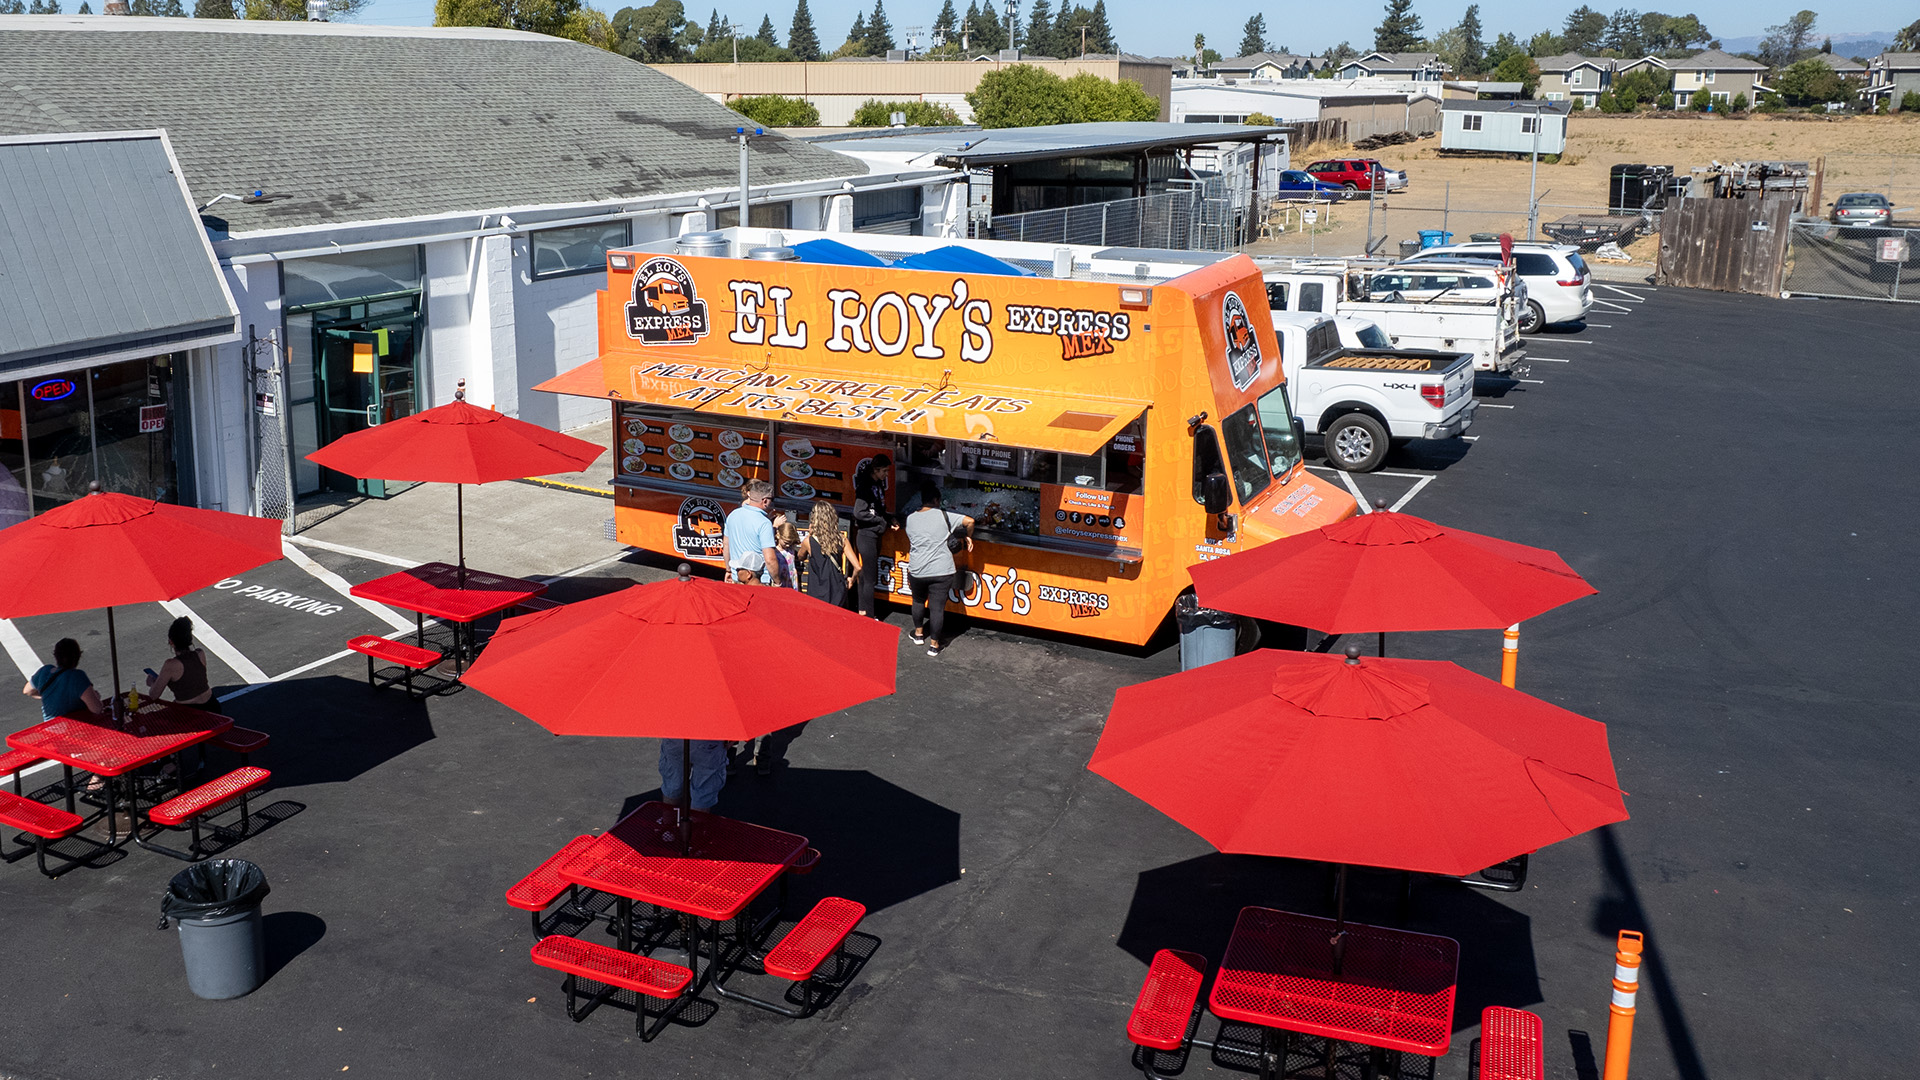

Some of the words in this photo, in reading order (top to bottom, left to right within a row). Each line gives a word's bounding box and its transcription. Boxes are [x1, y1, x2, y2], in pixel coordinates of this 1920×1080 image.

[639, 267, 653, 283] EL
[656, 262, 687, 282] ROY'S
[633, 315, 702, 331] EXPRESS
[728, 279, 807, 350] EL
[825, 277, 993, 364] ROY'S
[1005, 304, 1131, 341] EXPRESS
[665, 322, 695, 341] MEX
[1061, 328, 1114, 361] MEX
[34, 380, 71, 400] OPEN
[638, 361, 788, 389] MEXICAN
[786, 378, 930, 403] STREET
[928, 391, 1032, 413] EATS
[669, 386, 734, 402] AT
[722, 392, 795, 411] ITS
[793, 398, 898, 422] BEST
[1113, 443, 1136, 452] ORDERS
[1115, 435, 1134, 443] PHONE
[961, 446, 981, 455] ORDER
[982, 448, 990, 456] BY
[991, 450, 1011, 459] PHONE
[1075, 491, 1097, 500] Follow
[678, 535, 724, 548] EXPRES
[1054, 526, 1128, 542] @elroysexpressmex
[1195, 545, 1214, 553] SANTA
[1215, 547, 1231, 556] ROSA
[214, 578, 243, 590] O
[233, 585, 343, 616] PARKING
[948, 567, 1031, 616] OY'S
[1038, 585, 1109, 609] EXPRESS
[1070, 602, 1100, 618] MEX
